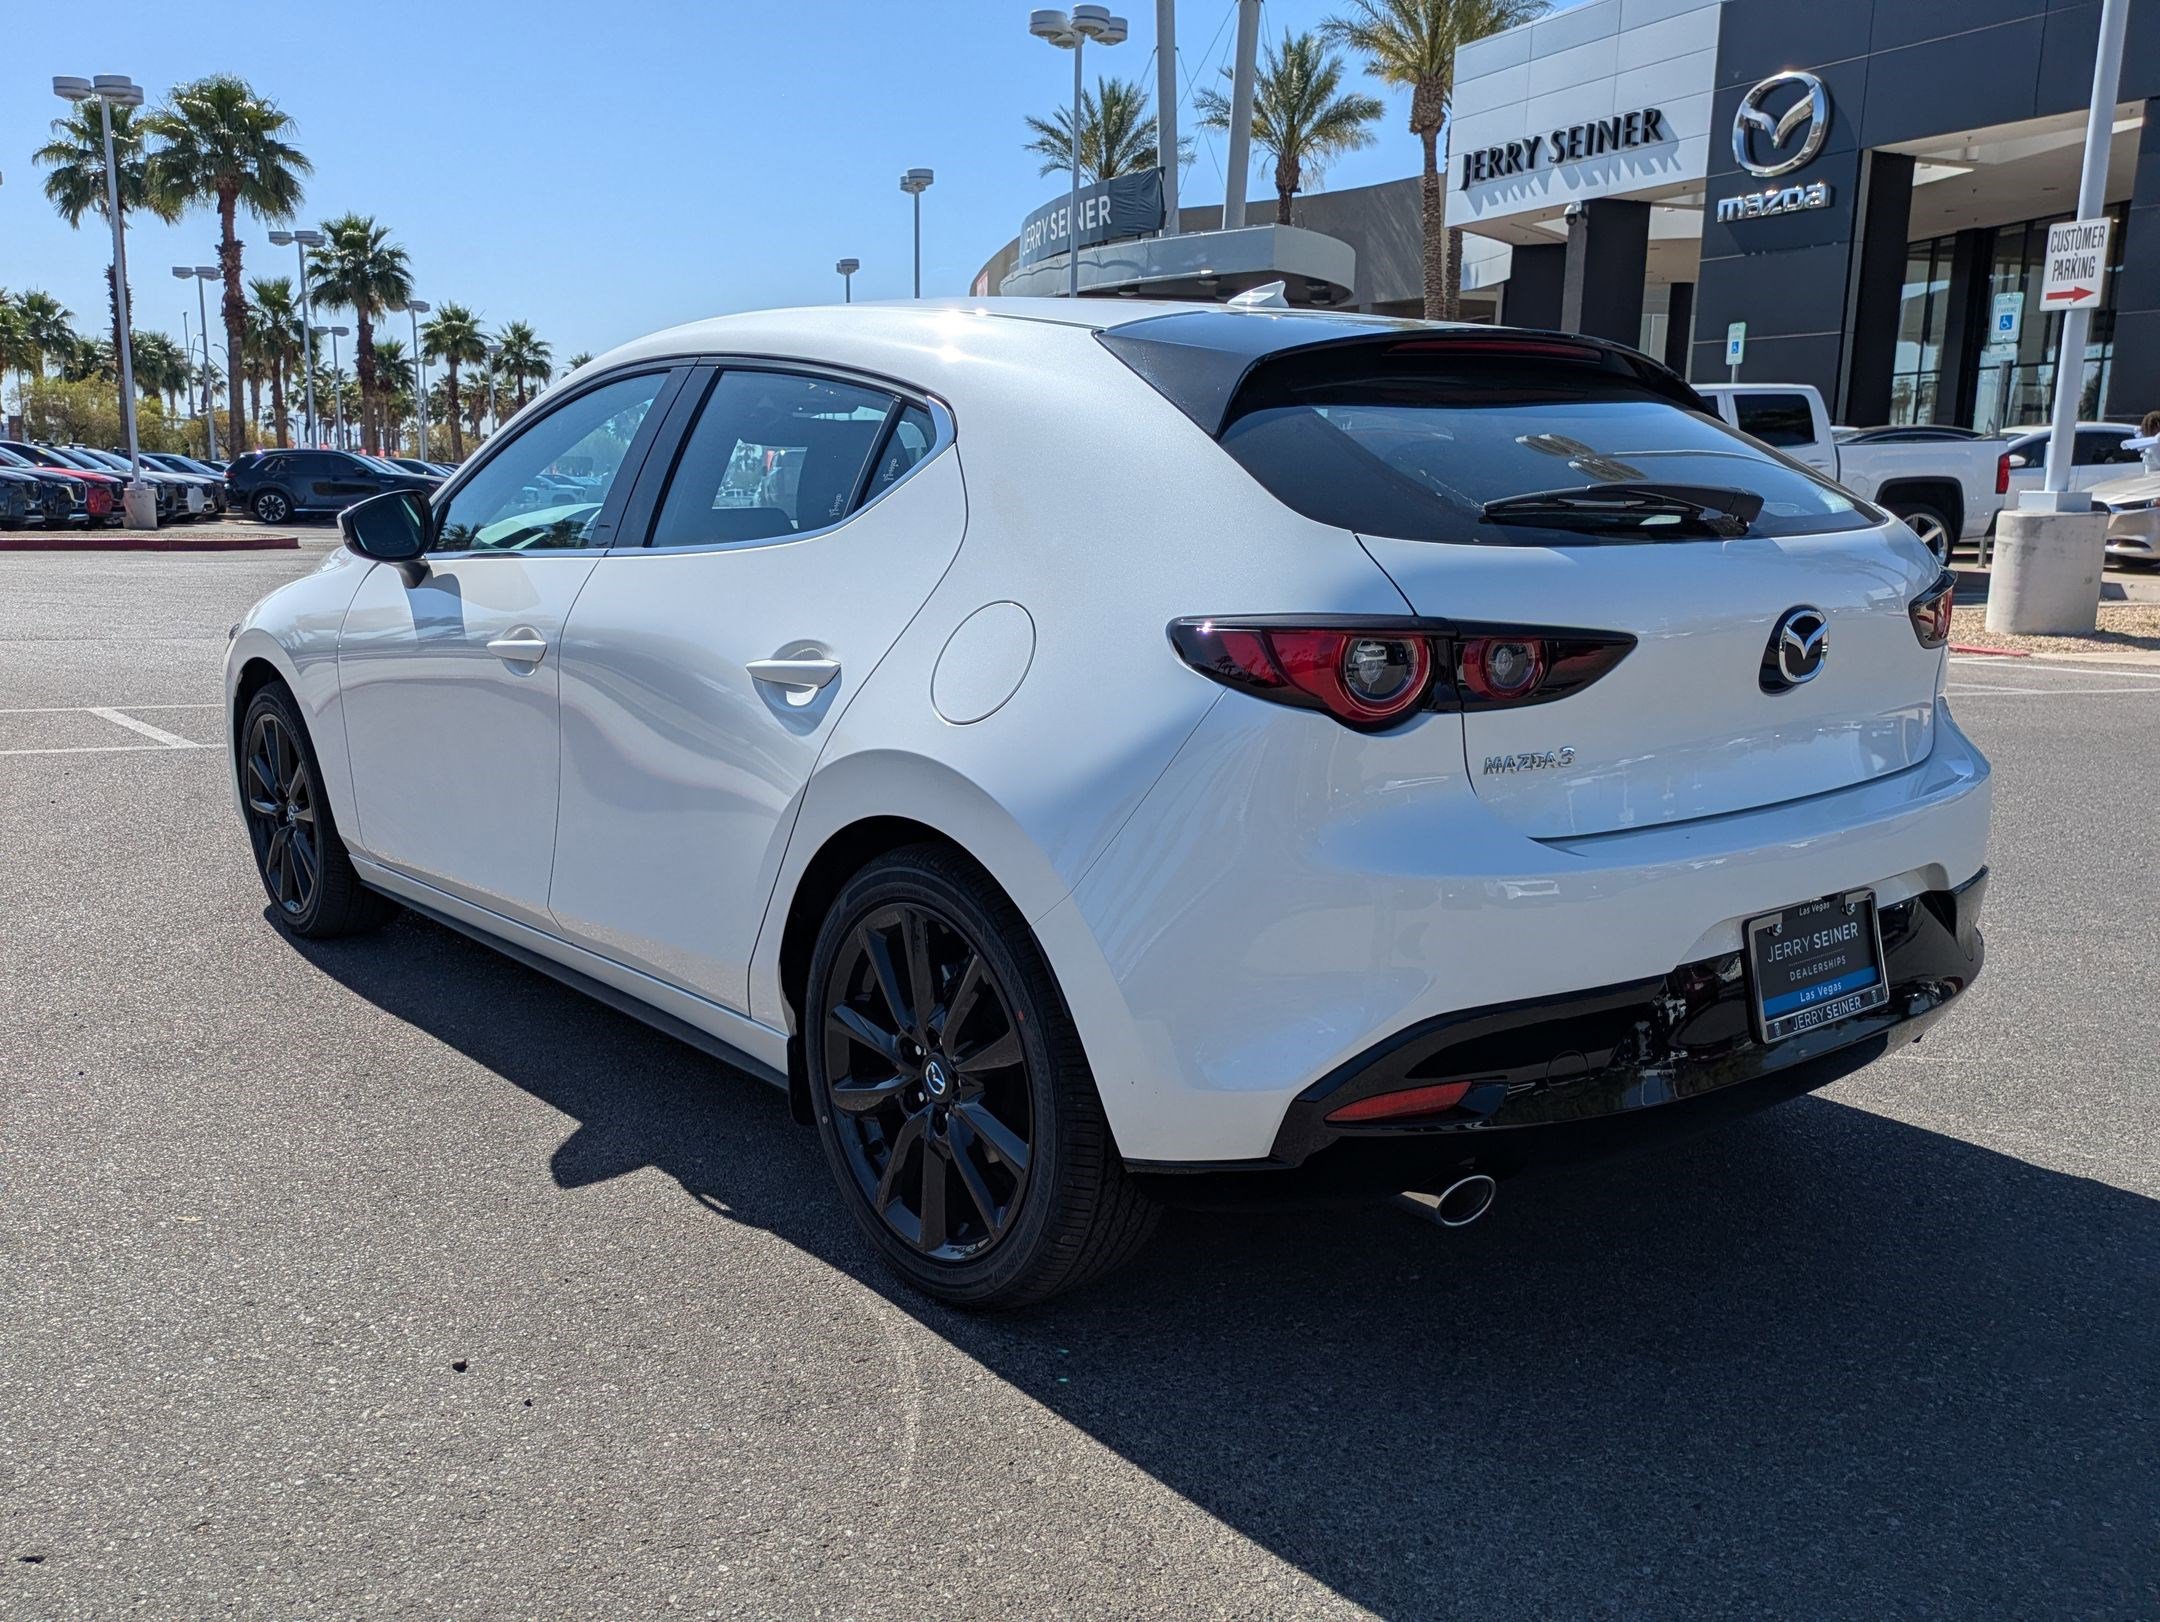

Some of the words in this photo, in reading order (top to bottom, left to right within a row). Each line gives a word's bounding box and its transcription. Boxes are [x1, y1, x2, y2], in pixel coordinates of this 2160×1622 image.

[1460, 136, 1542, 191] JERRY
[1548, 108, 1663, 164] SEINER
[2050, 225, 2106, 253] CUSTOMER
[2051, 255, 2096, 282] PARKING
[1799, 906, 1811, 917] Las
[1811, 901, 1831, 913] Vegas
[1767, 935, 1810, 963] JERRY
[1813, 921, 1859, 949] SEINER
[1789, 955, 1847, 982] DEALERSHIPS
[1800, 990, 1815, 1003] Las
[1817, 981, 1842, 997] Vegas
[1793, 1007, 1825, 1031] JERRY
[1826, 996, 1862, 1019] SEINER
